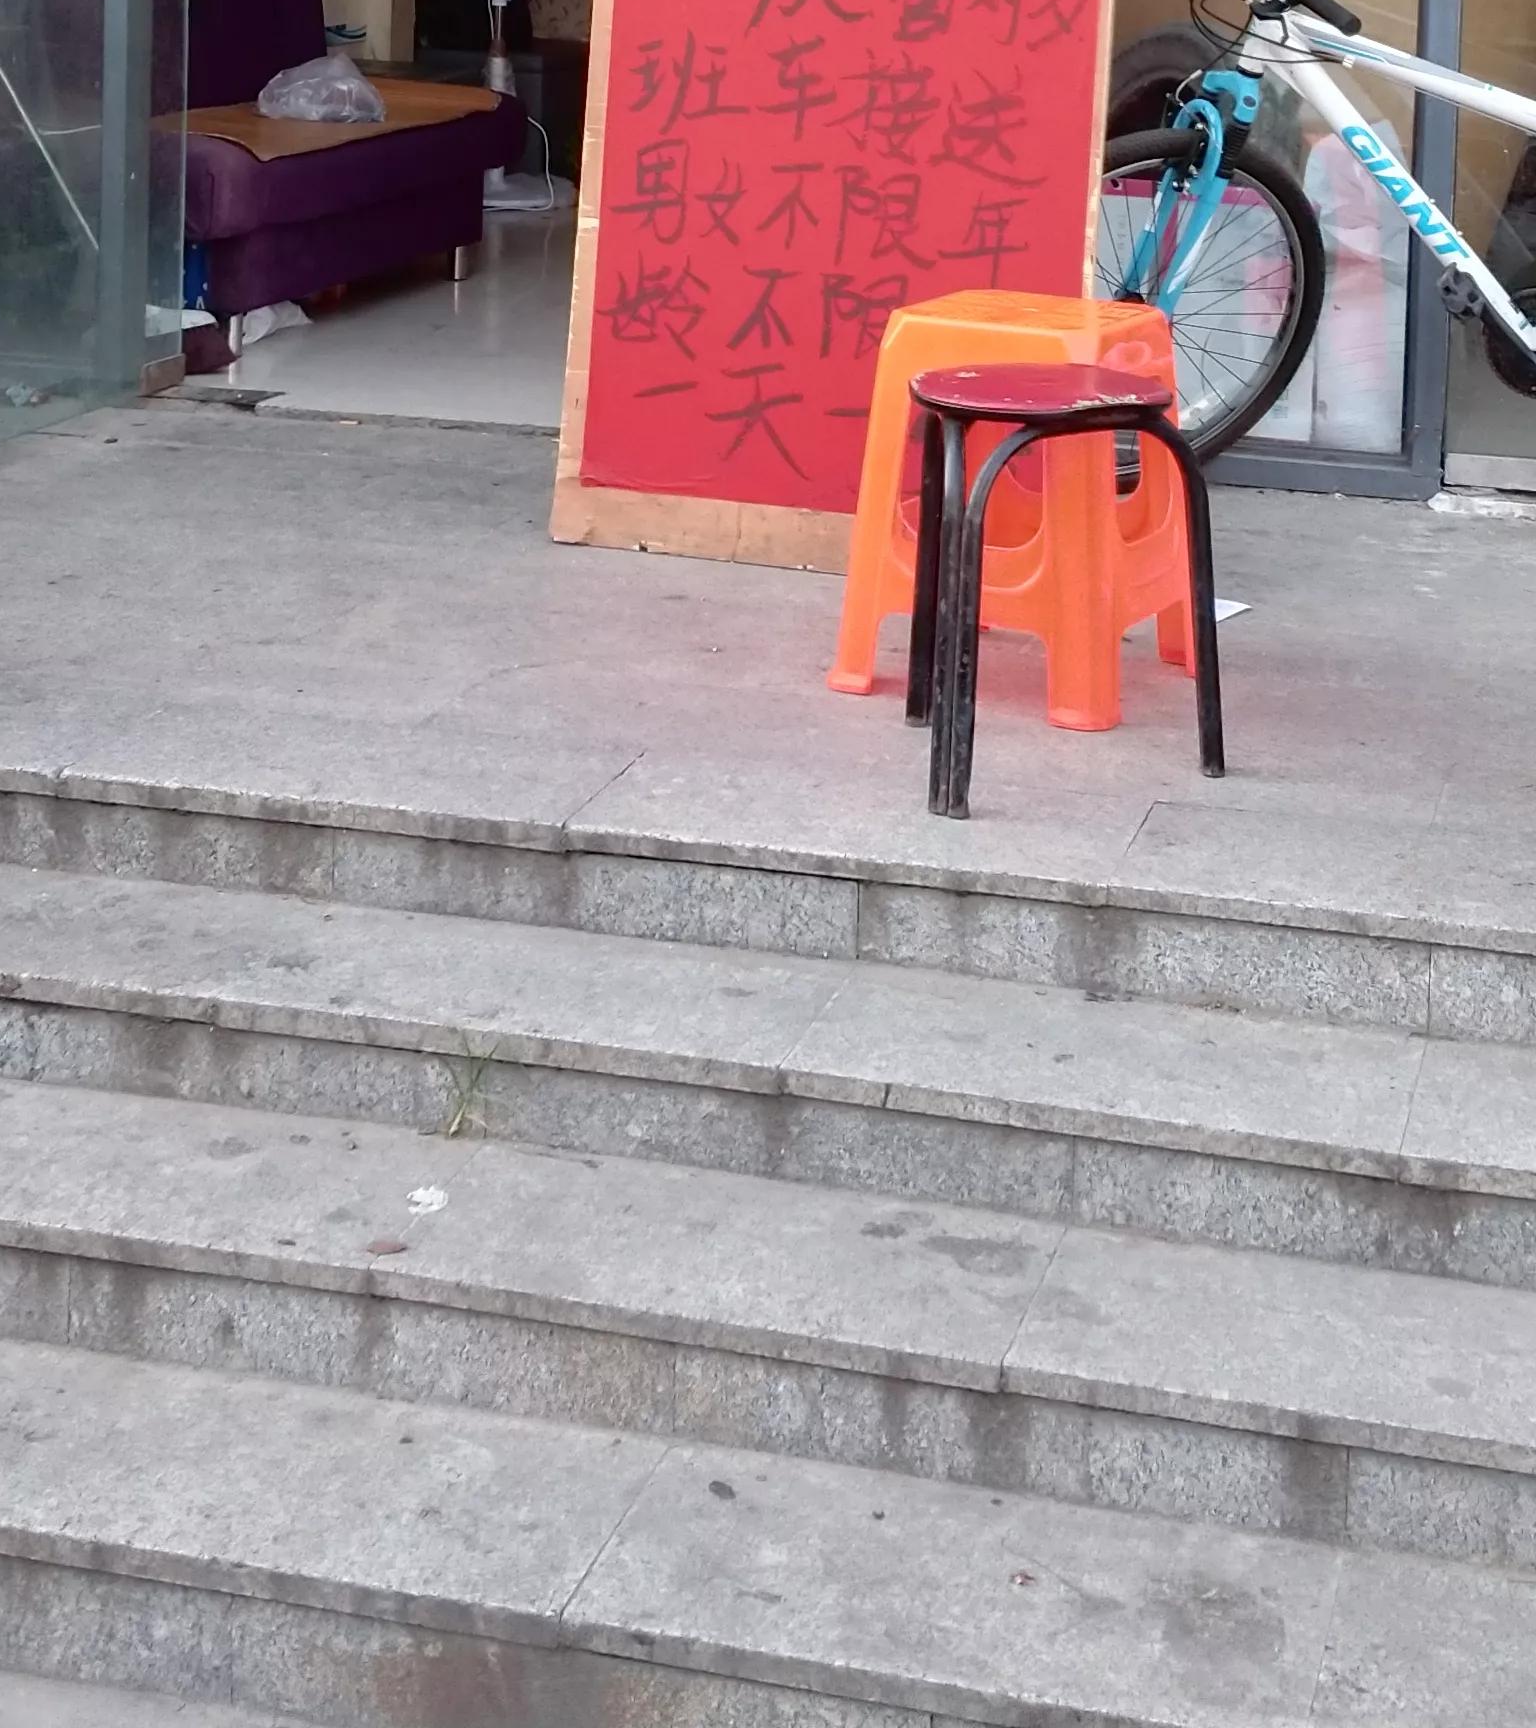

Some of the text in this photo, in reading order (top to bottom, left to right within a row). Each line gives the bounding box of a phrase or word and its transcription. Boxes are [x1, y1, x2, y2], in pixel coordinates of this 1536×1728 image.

[627, 30, 1047, 188] 班车接送
[1339, 125, 1472, 262] GIANT
